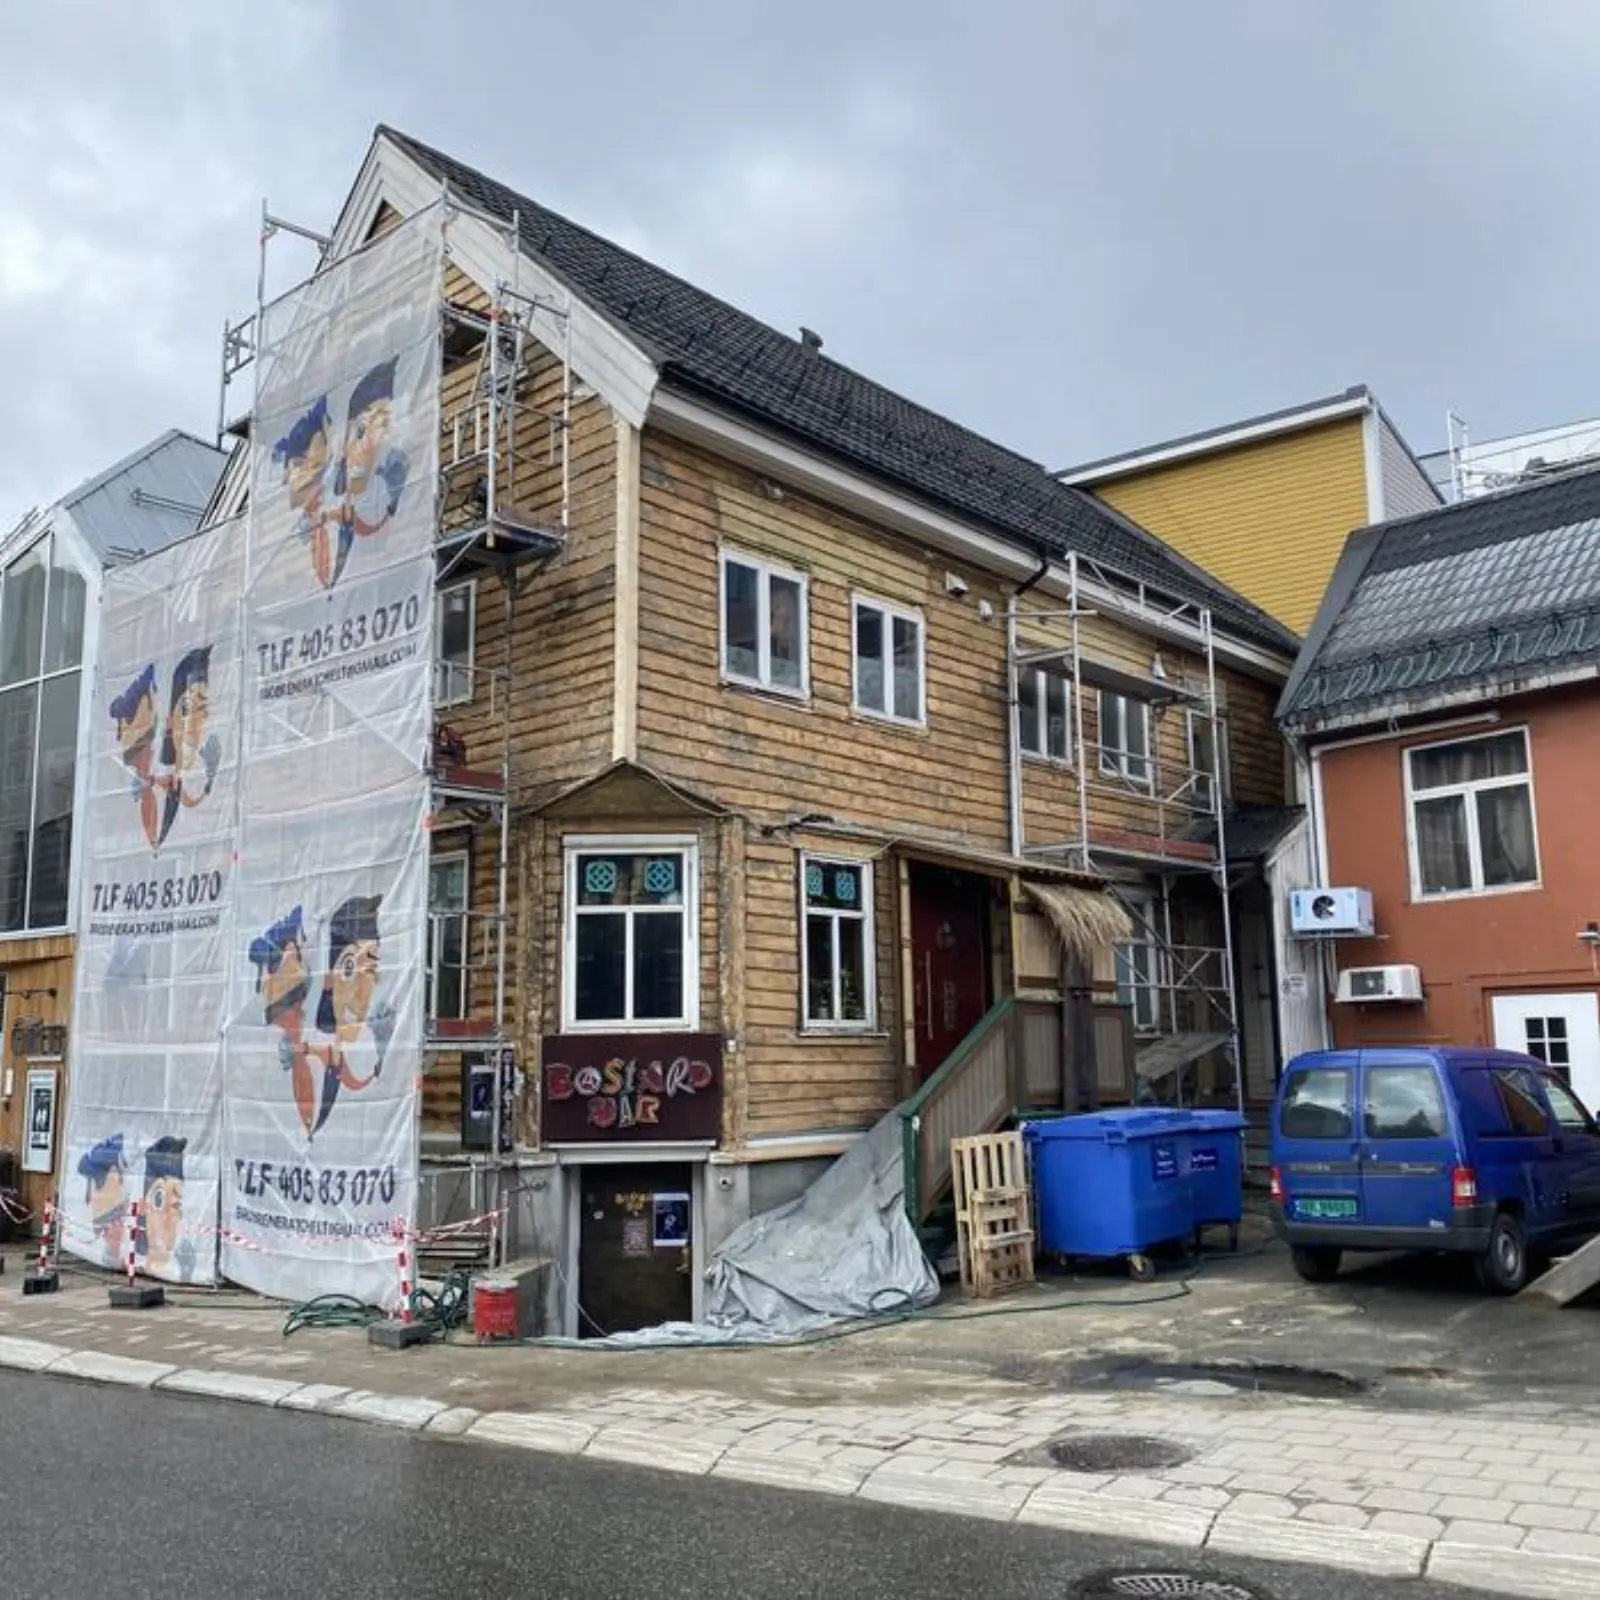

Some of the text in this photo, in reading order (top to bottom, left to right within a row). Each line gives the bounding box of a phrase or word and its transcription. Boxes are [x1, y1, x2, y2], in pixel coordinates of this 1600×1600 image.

[257, 594, 418, 676] TLF 405 83 070
[93, 870, 222, 912] TLF 405 83 070
[235, 1158, 396, 1206] TLF 405 83 070
